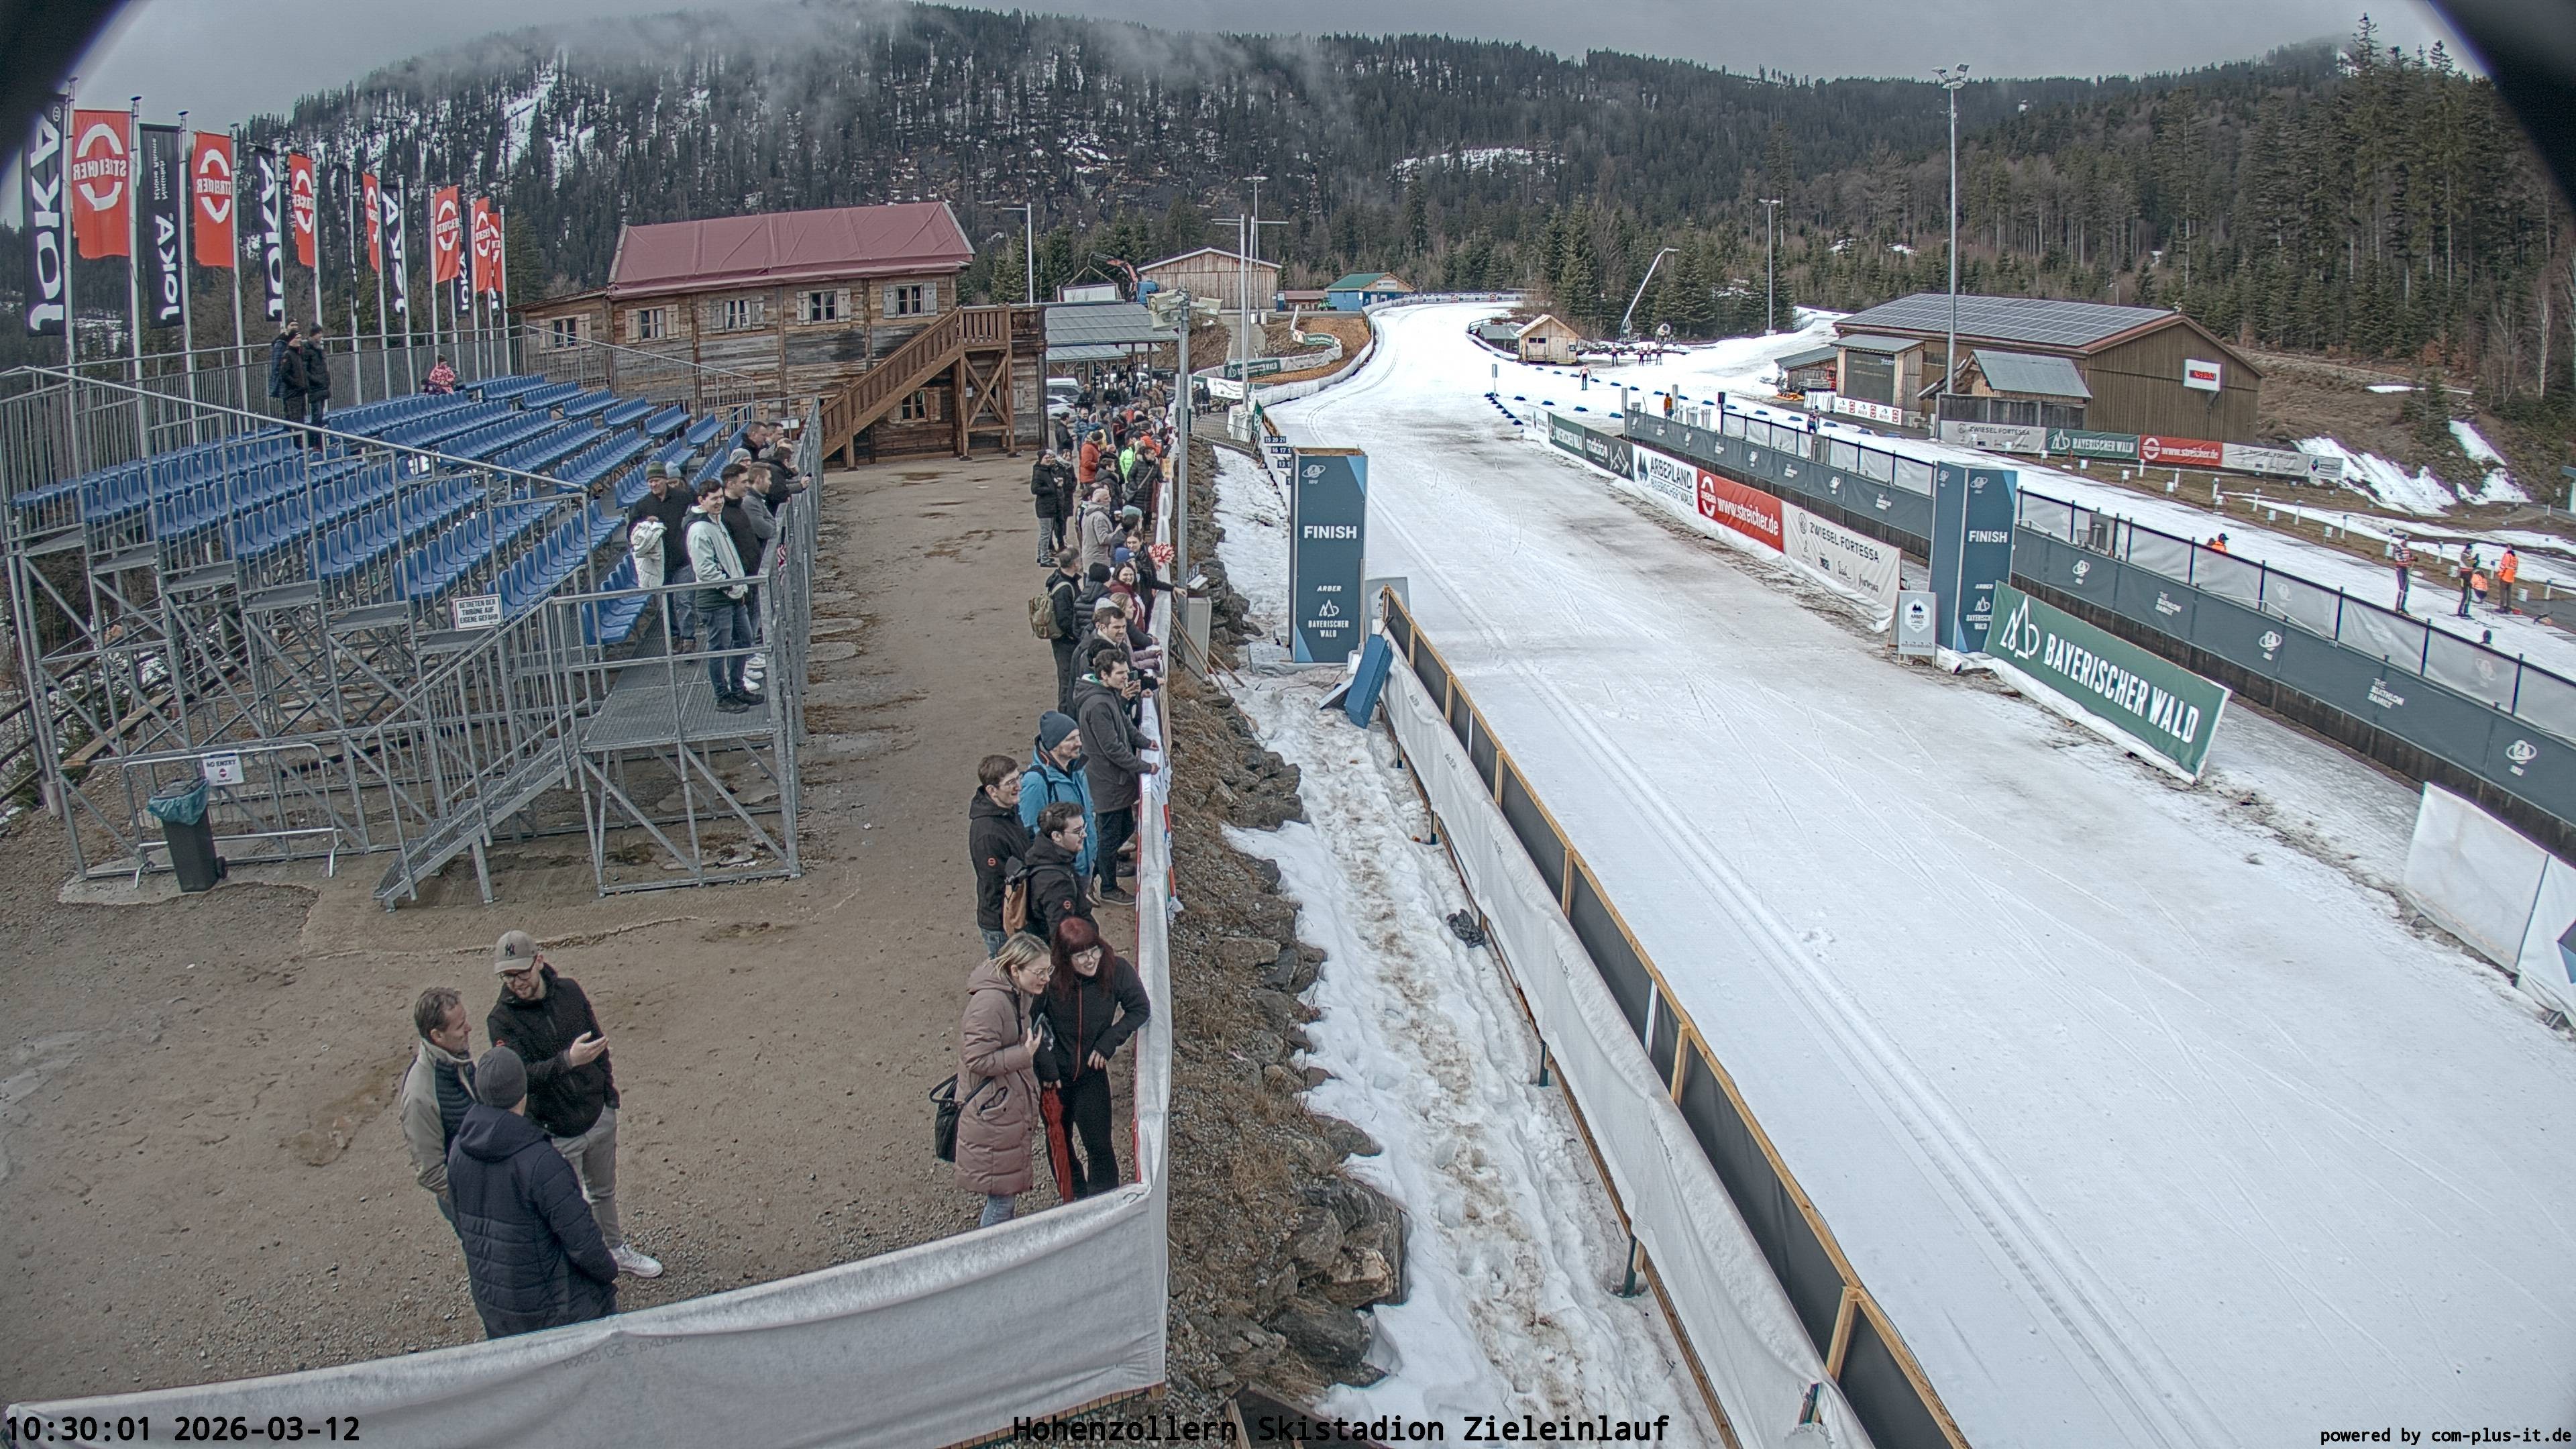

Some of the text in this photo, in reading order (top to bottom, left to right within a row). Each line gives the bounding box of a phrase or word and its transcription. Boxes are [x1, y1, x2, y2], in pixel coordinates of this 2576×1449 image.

[2072, 437, 2134, 453] BAYERISCHER WALD
[1650, 456, 1693, 490] ARBERLAND
[1717, 497, 1779, 536] www.streicher.de
[1303, 525, 1357, 539] FINISH
[1968, 530, 2008, 543] FINISH
[1809, 521, 1839, 546] ZWIESEL
[1840, 536, 1880, 564] FORTESSA
[1308, 620, 1349, 629] BAYERISCHER
[1320, 629, 1337, 638] WALD
[2043, 633, 2200, 744] BAYERISCHER WALD
